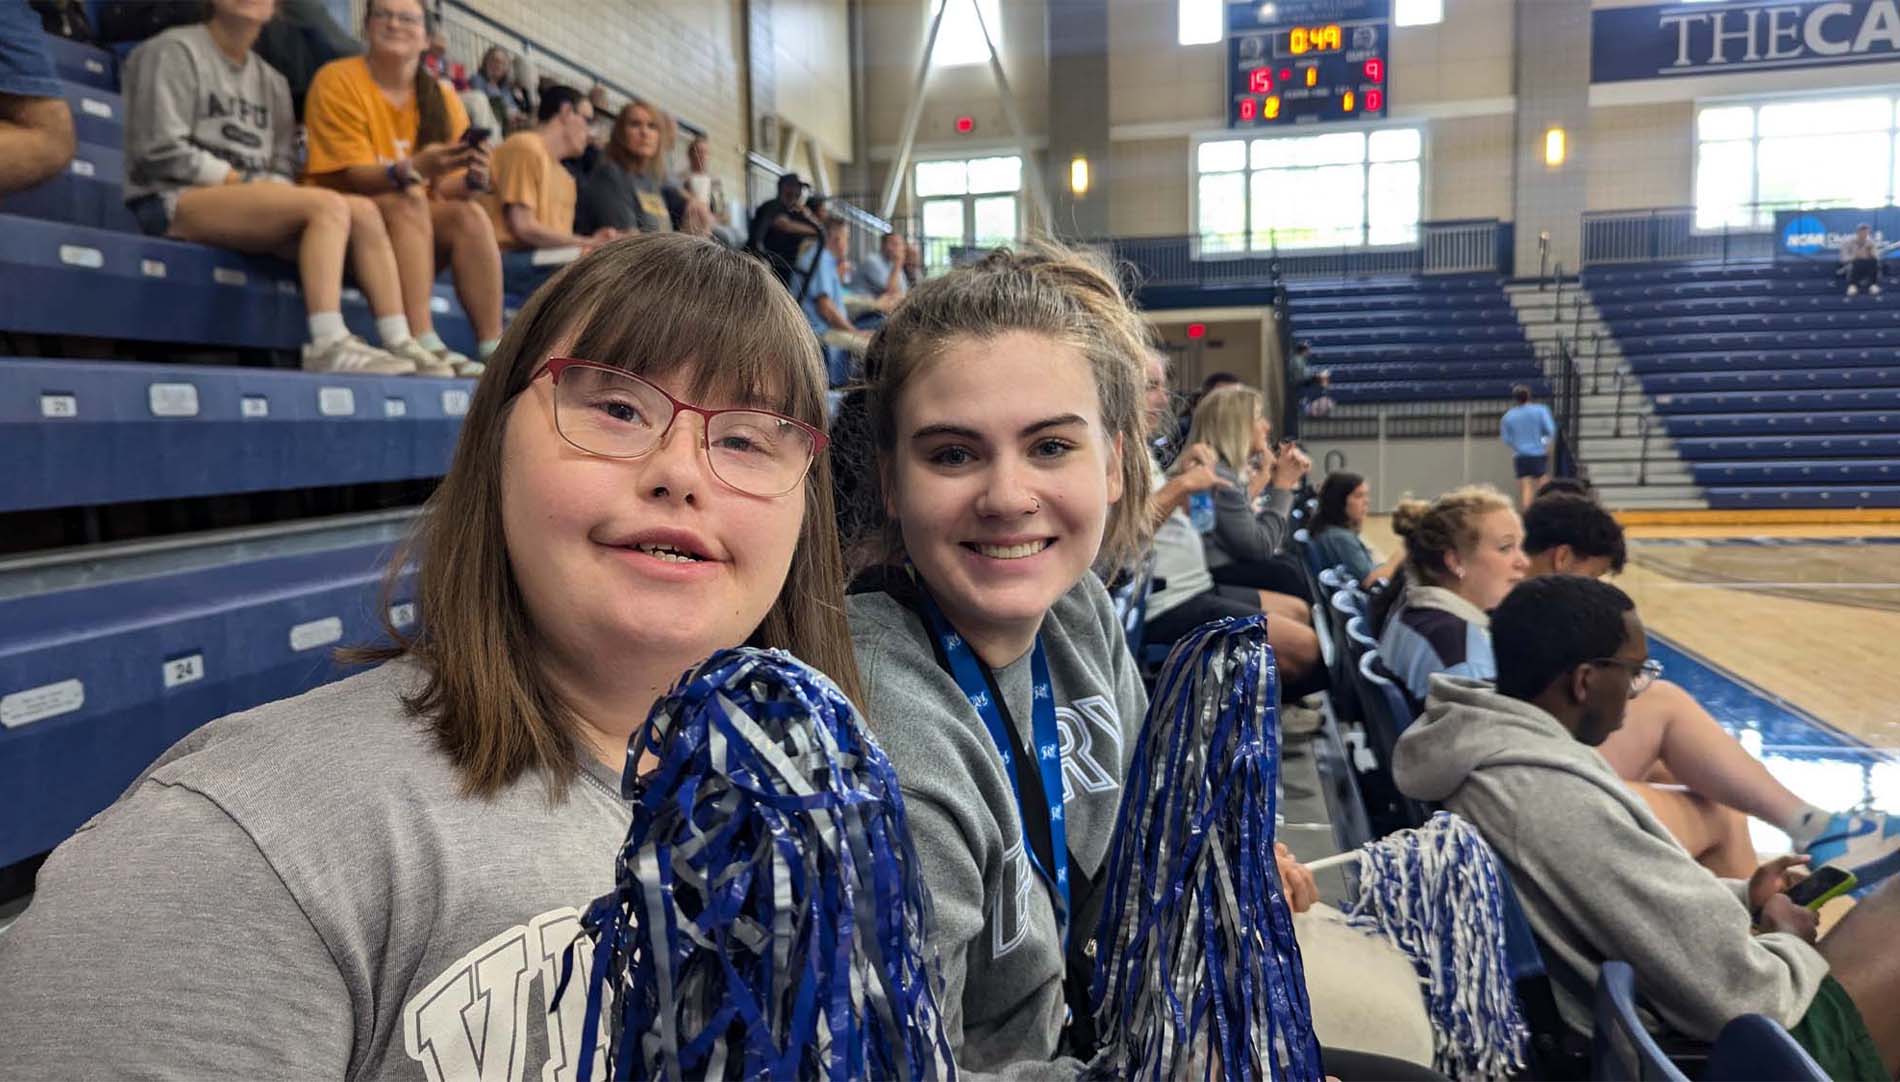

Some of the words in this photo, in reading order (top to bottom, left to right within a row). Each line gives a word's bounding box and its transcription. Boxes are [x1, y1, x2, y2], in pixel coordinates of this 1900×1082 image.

[1290, 25, 1342, 54] 0:49
[1249, 66, 1274, 93] 15
[1306, 66, 1318, 87] 1
[1363, 58, 1384, 84] 9
[1239, 97, 1257, 121] 0
[1364, 89, 1383, 112] 0
[175, 662, 193, 679] 24
